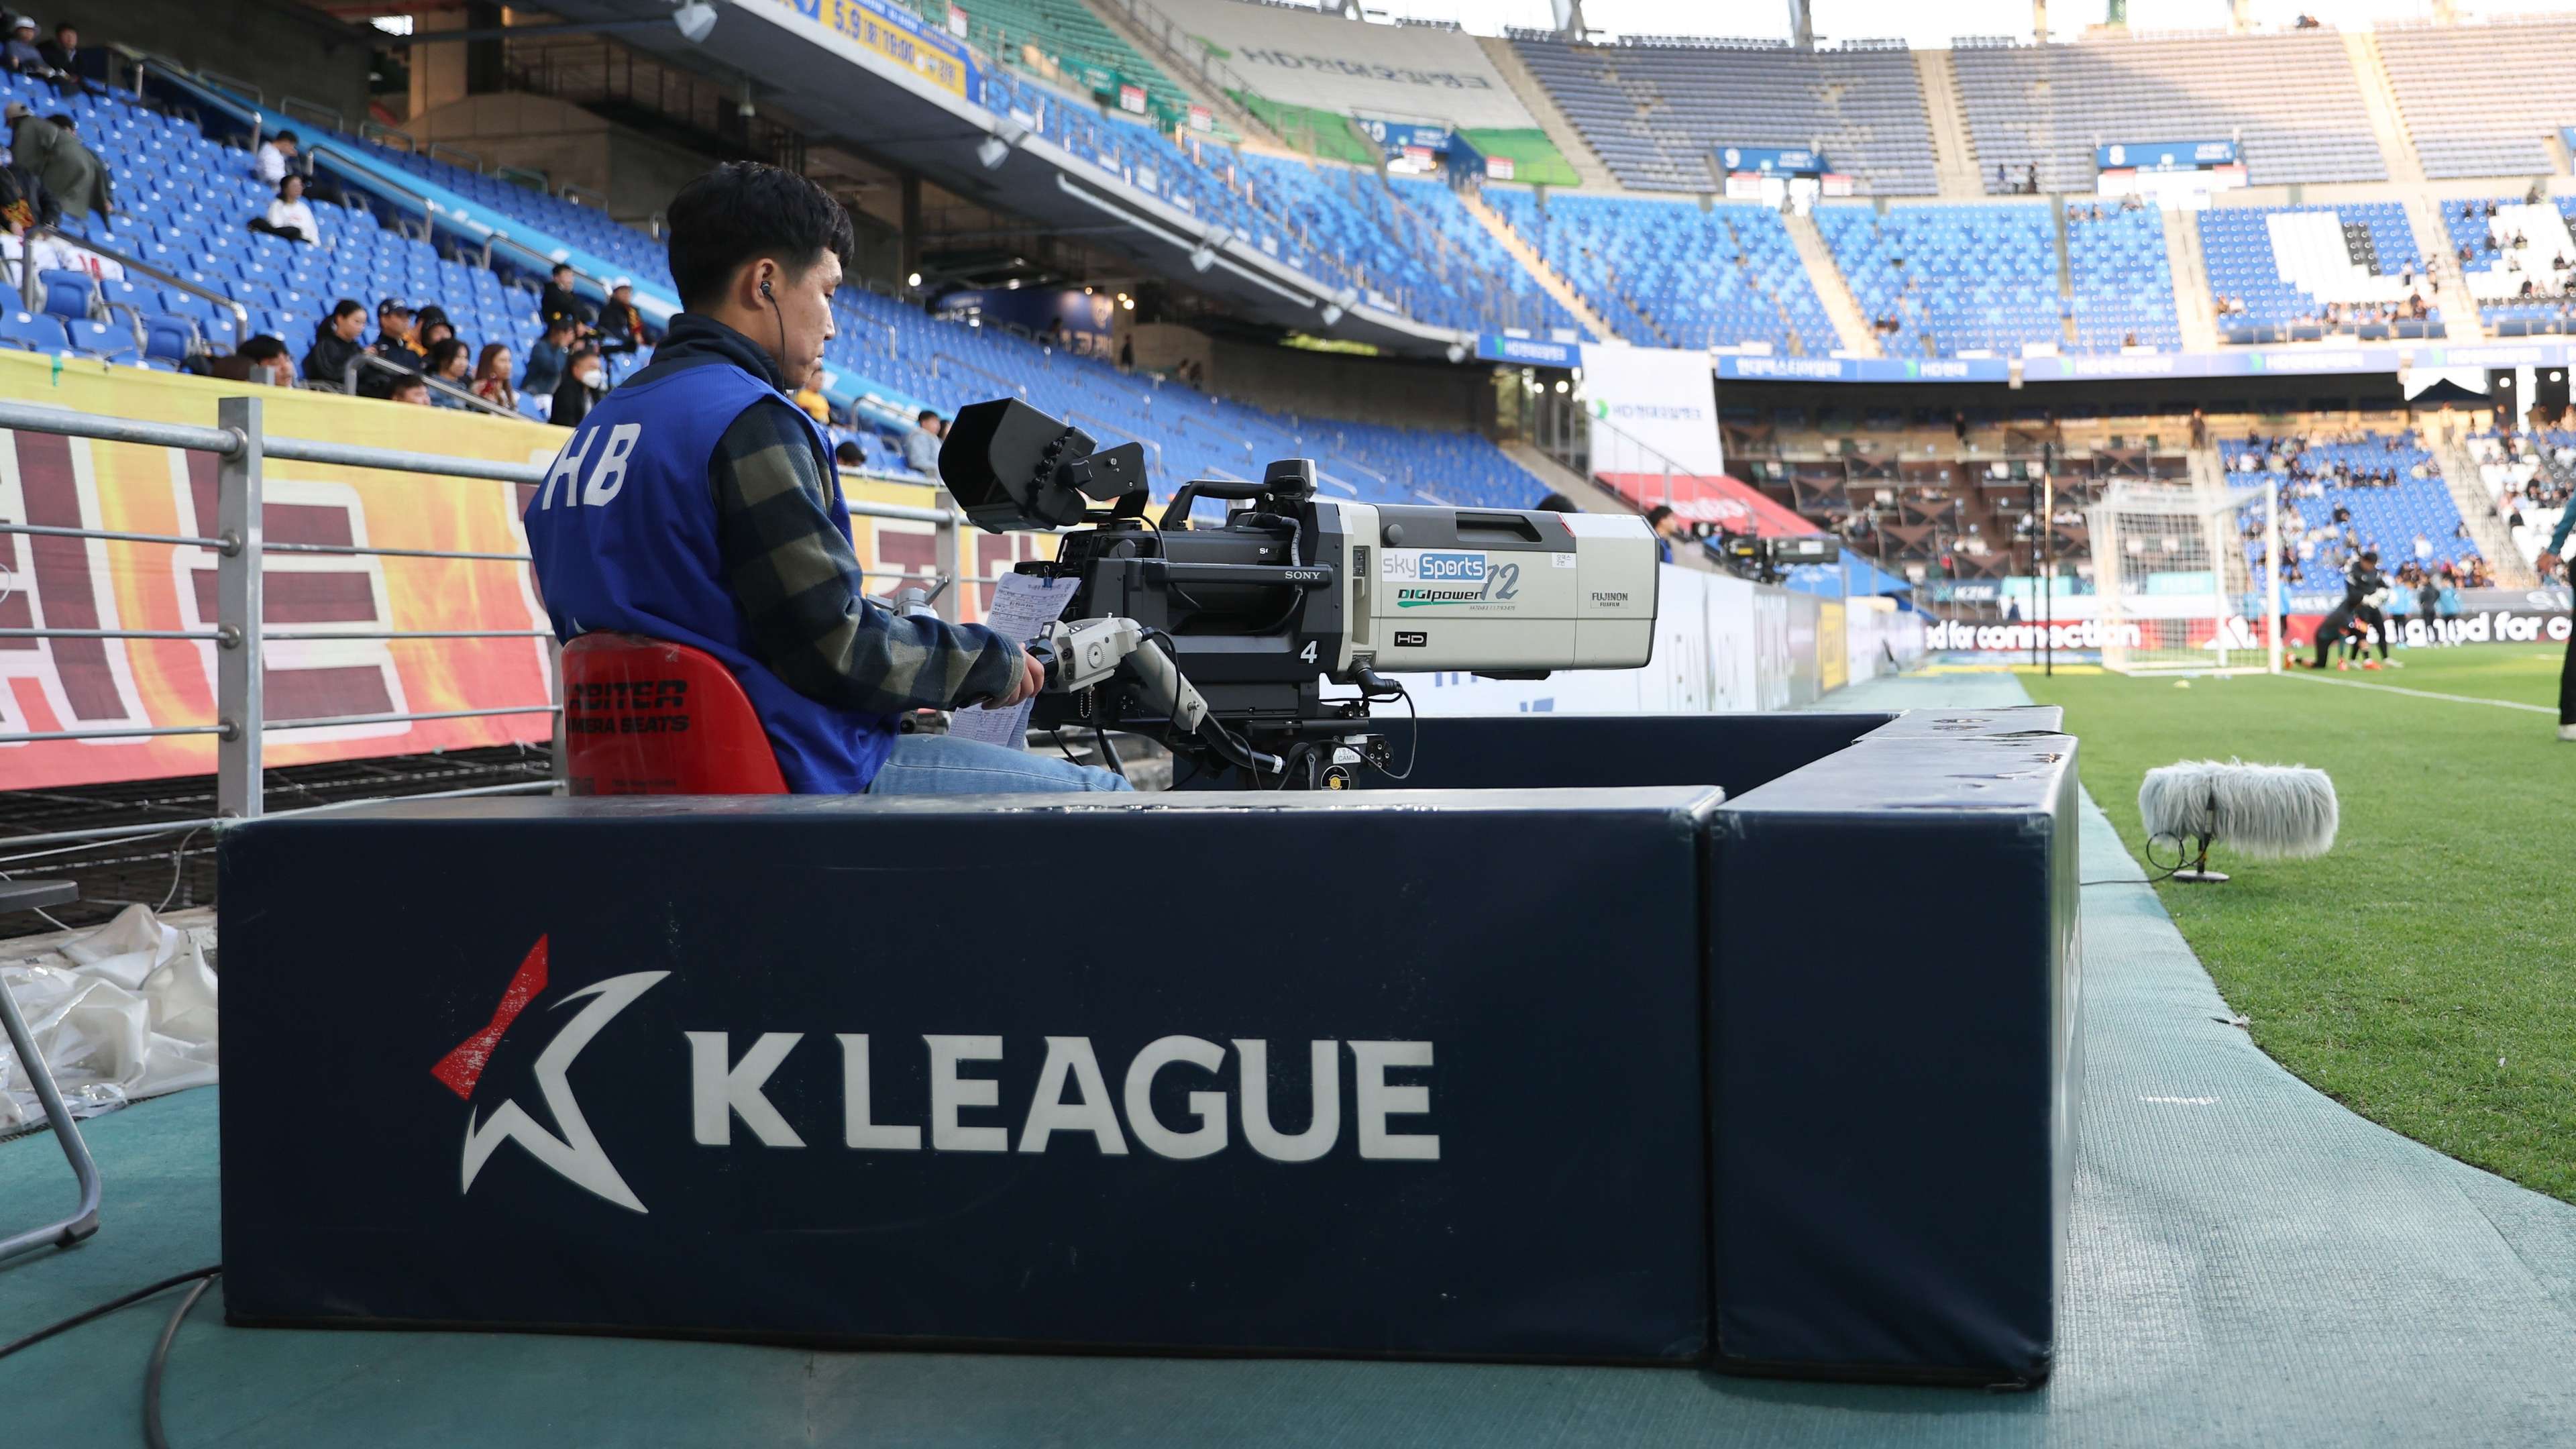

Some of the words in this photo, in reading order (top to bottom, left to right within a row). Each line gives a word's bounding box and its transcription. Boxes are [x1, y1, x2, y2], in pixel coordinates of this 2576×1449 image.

[542, 423, 641, 511] HB
[1285, 571, 1320, 580] SONY
[1383, 554, 1417, 578] sky
[1421, 556, 1483, 579] Sports
[1397, 589, 1483, 602] DIGIpower
[1591, 592, 1629, 601] FUJINON
[1948, 619, 1977, 649] for
[2493, 610, 2543, 641] for
[1397, 634, 1425, 644] HD
[1300, 641, 1318, 664] 4
[620, 715, 690, 733] SEATS
[684, 1031, 806, 1146] K
[835, 1034, 1440, 1162] LEAGUE
